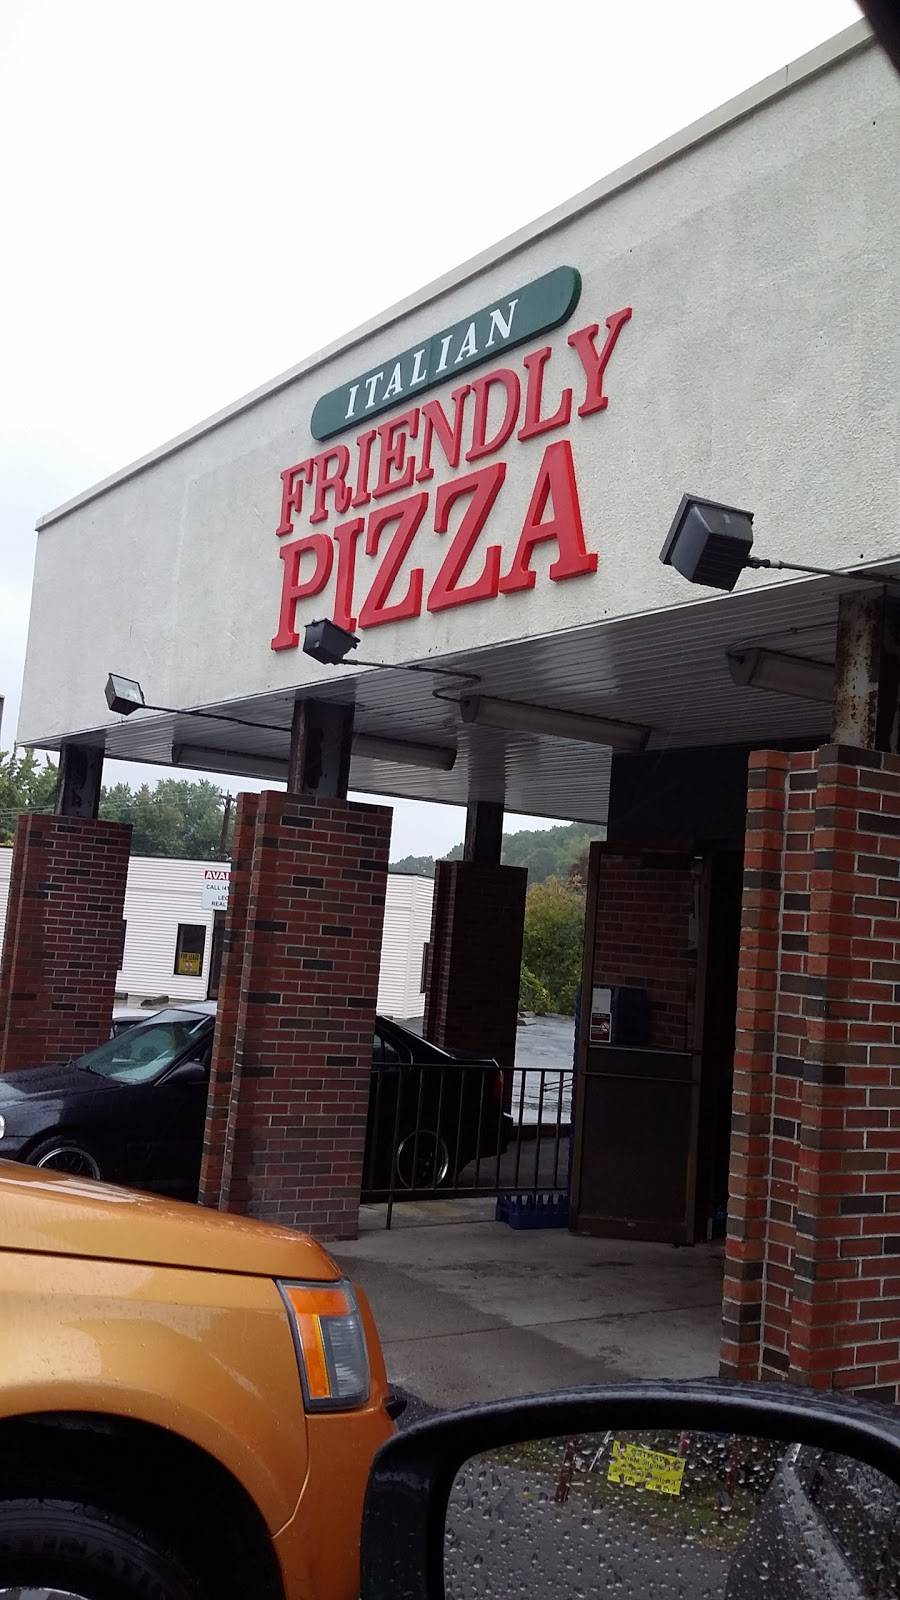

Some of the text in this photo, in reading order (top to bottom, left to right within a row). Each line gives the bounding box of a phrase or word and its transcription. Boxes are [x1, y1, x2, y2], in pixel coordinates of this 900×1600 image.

[276, 307, 633, 537] FRIENDLY
[344, 299, 519, 419] ITALIAN
[271, 439, 598, 651] PIZZA
